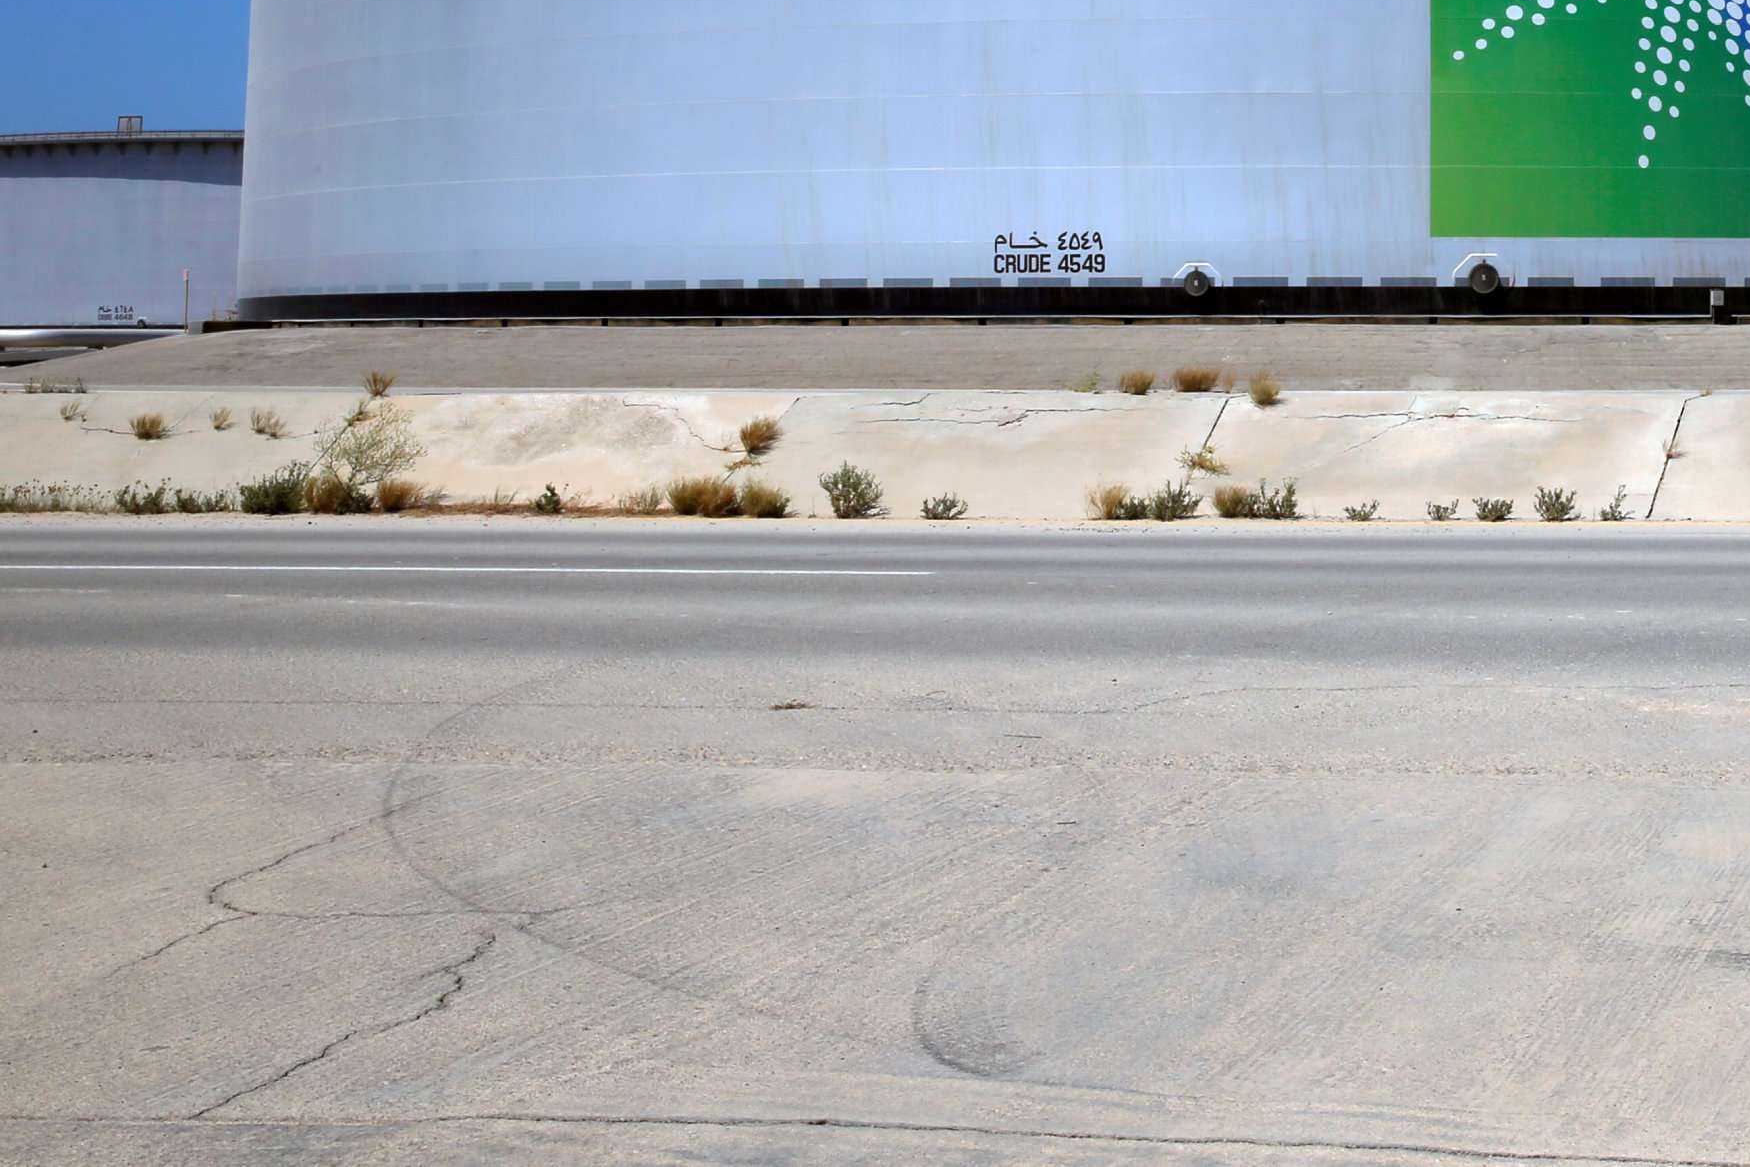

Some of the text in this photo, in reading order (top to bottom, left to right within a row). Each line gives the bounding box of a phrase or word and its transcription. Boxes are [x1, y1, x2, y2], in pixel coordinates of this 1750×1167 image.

[994, 231, 1104, 254] ٤٥٤٩ خام
[993, 253, 1106, 274] CRUDE 4549
